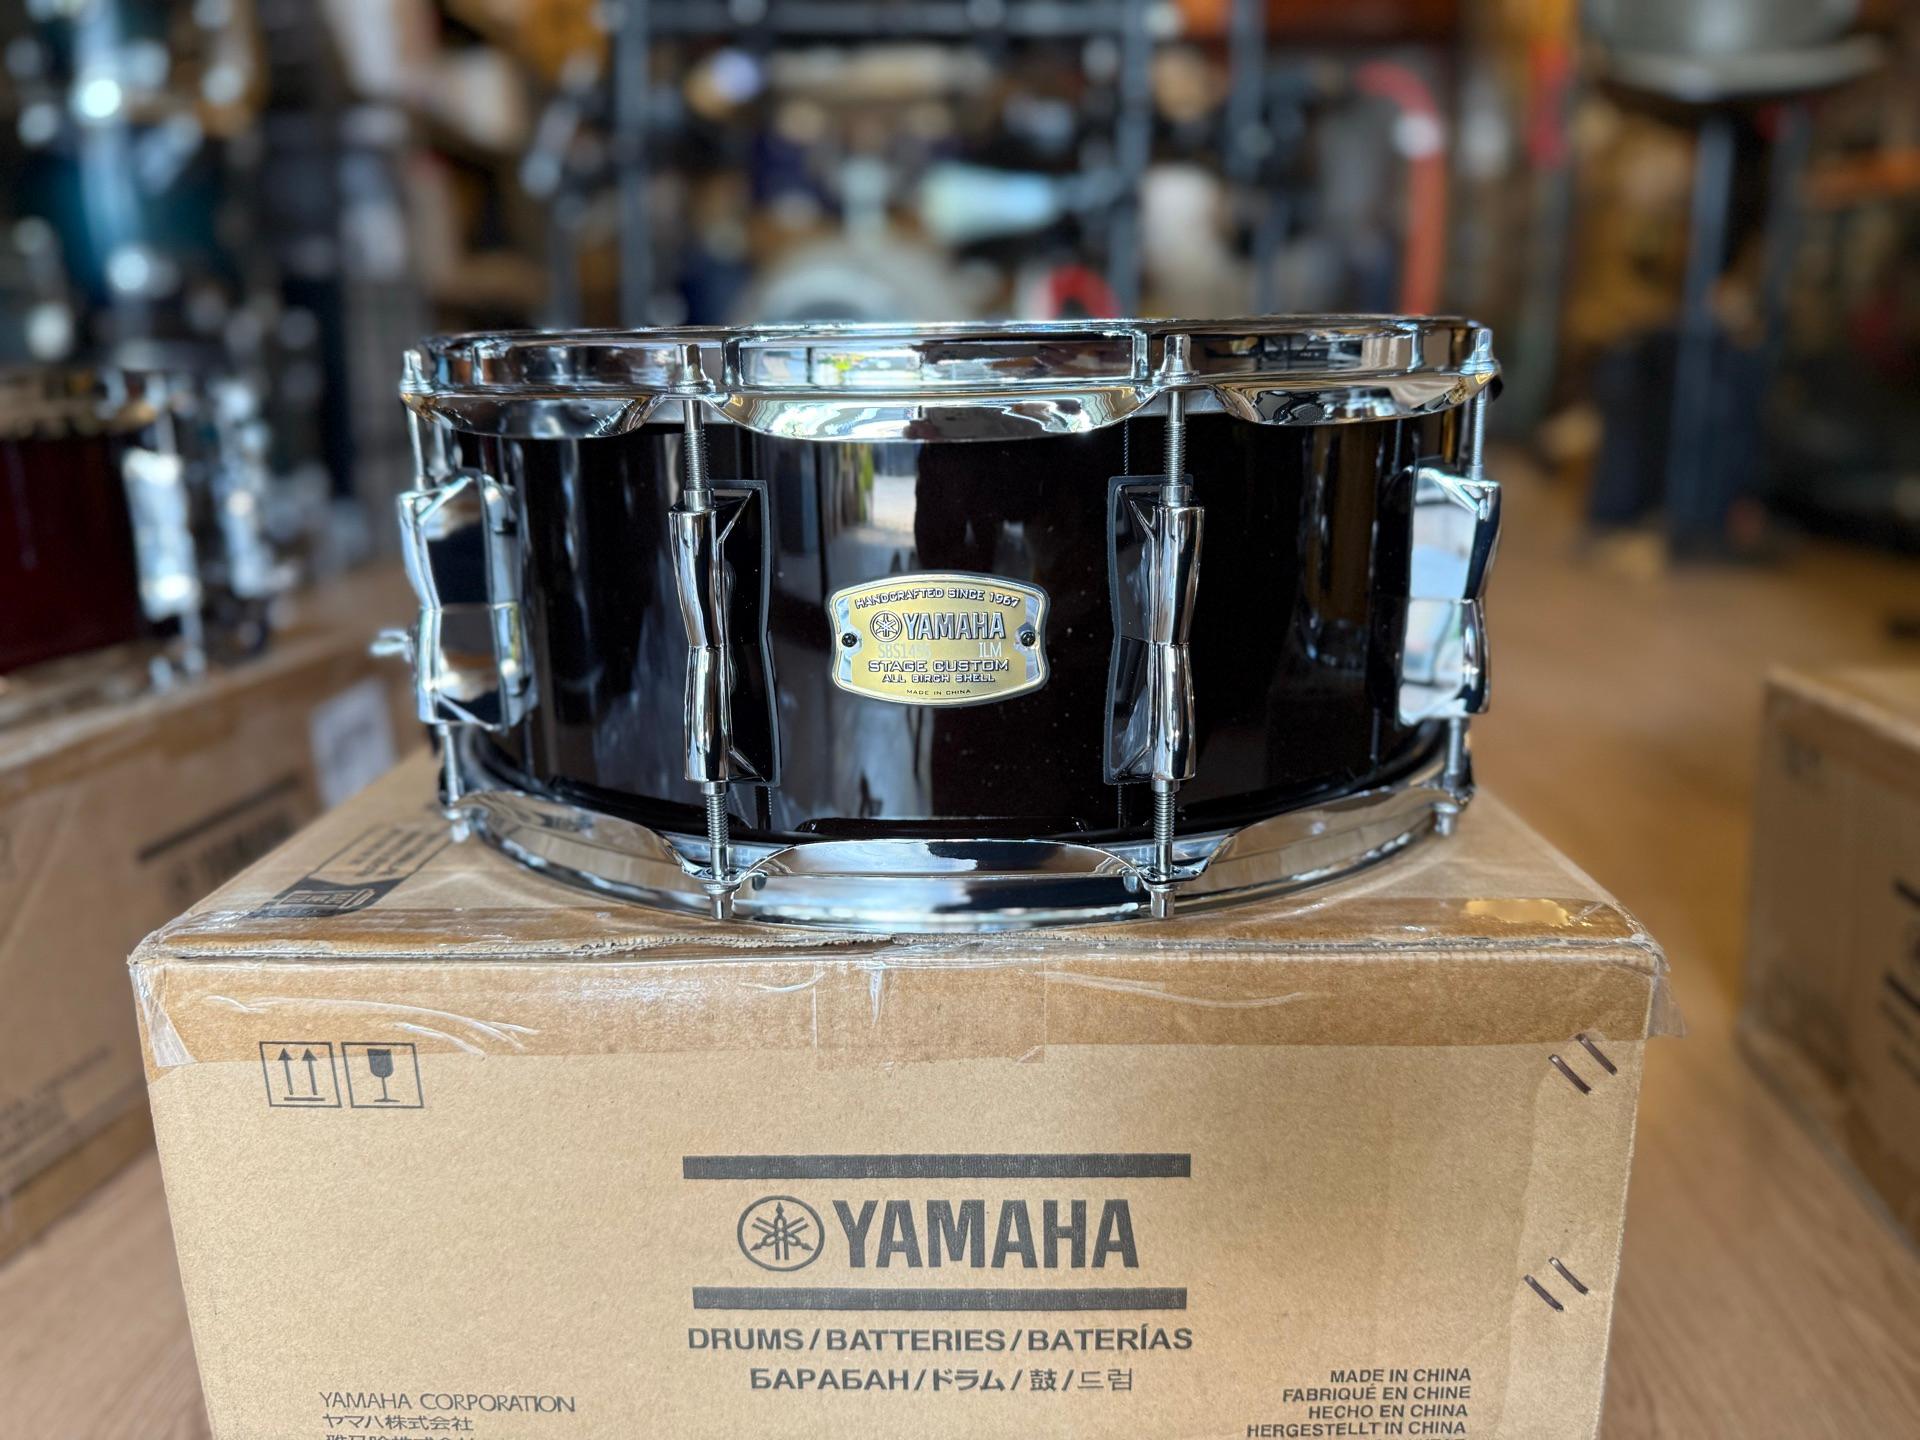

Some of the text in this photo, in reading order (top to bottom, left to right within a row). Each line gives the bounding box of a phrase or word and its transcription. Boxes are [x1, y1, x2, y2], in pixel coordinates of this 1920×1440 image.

[855, 588, 1021, 609] HANDCRAFTED SINCE 1967
[903, 612, 1006, 640] YAMAHA
[868, 659, 1009, 672] STAGE CUSTOM
[882, 674, 996, 683] ALL BIRCH SHELL
[832, 1199, 1140, 1269] YAMAHA
[1330, 1368, 1472, 1383] MADE IN CHINA
[1282, 1383, 1471, 1402] FABRIQUÉ EN CHINE
[319, 1392, 576, 1412] YAMAHA CORPORATION
[1308, 1404, 1468, 1419] HECHO EN CHINA
[322, 1414, 474, 1431] ヤマハ株式会社
[1246, 1421, 1466, 1438] HERGESTELLT IN CHINA
